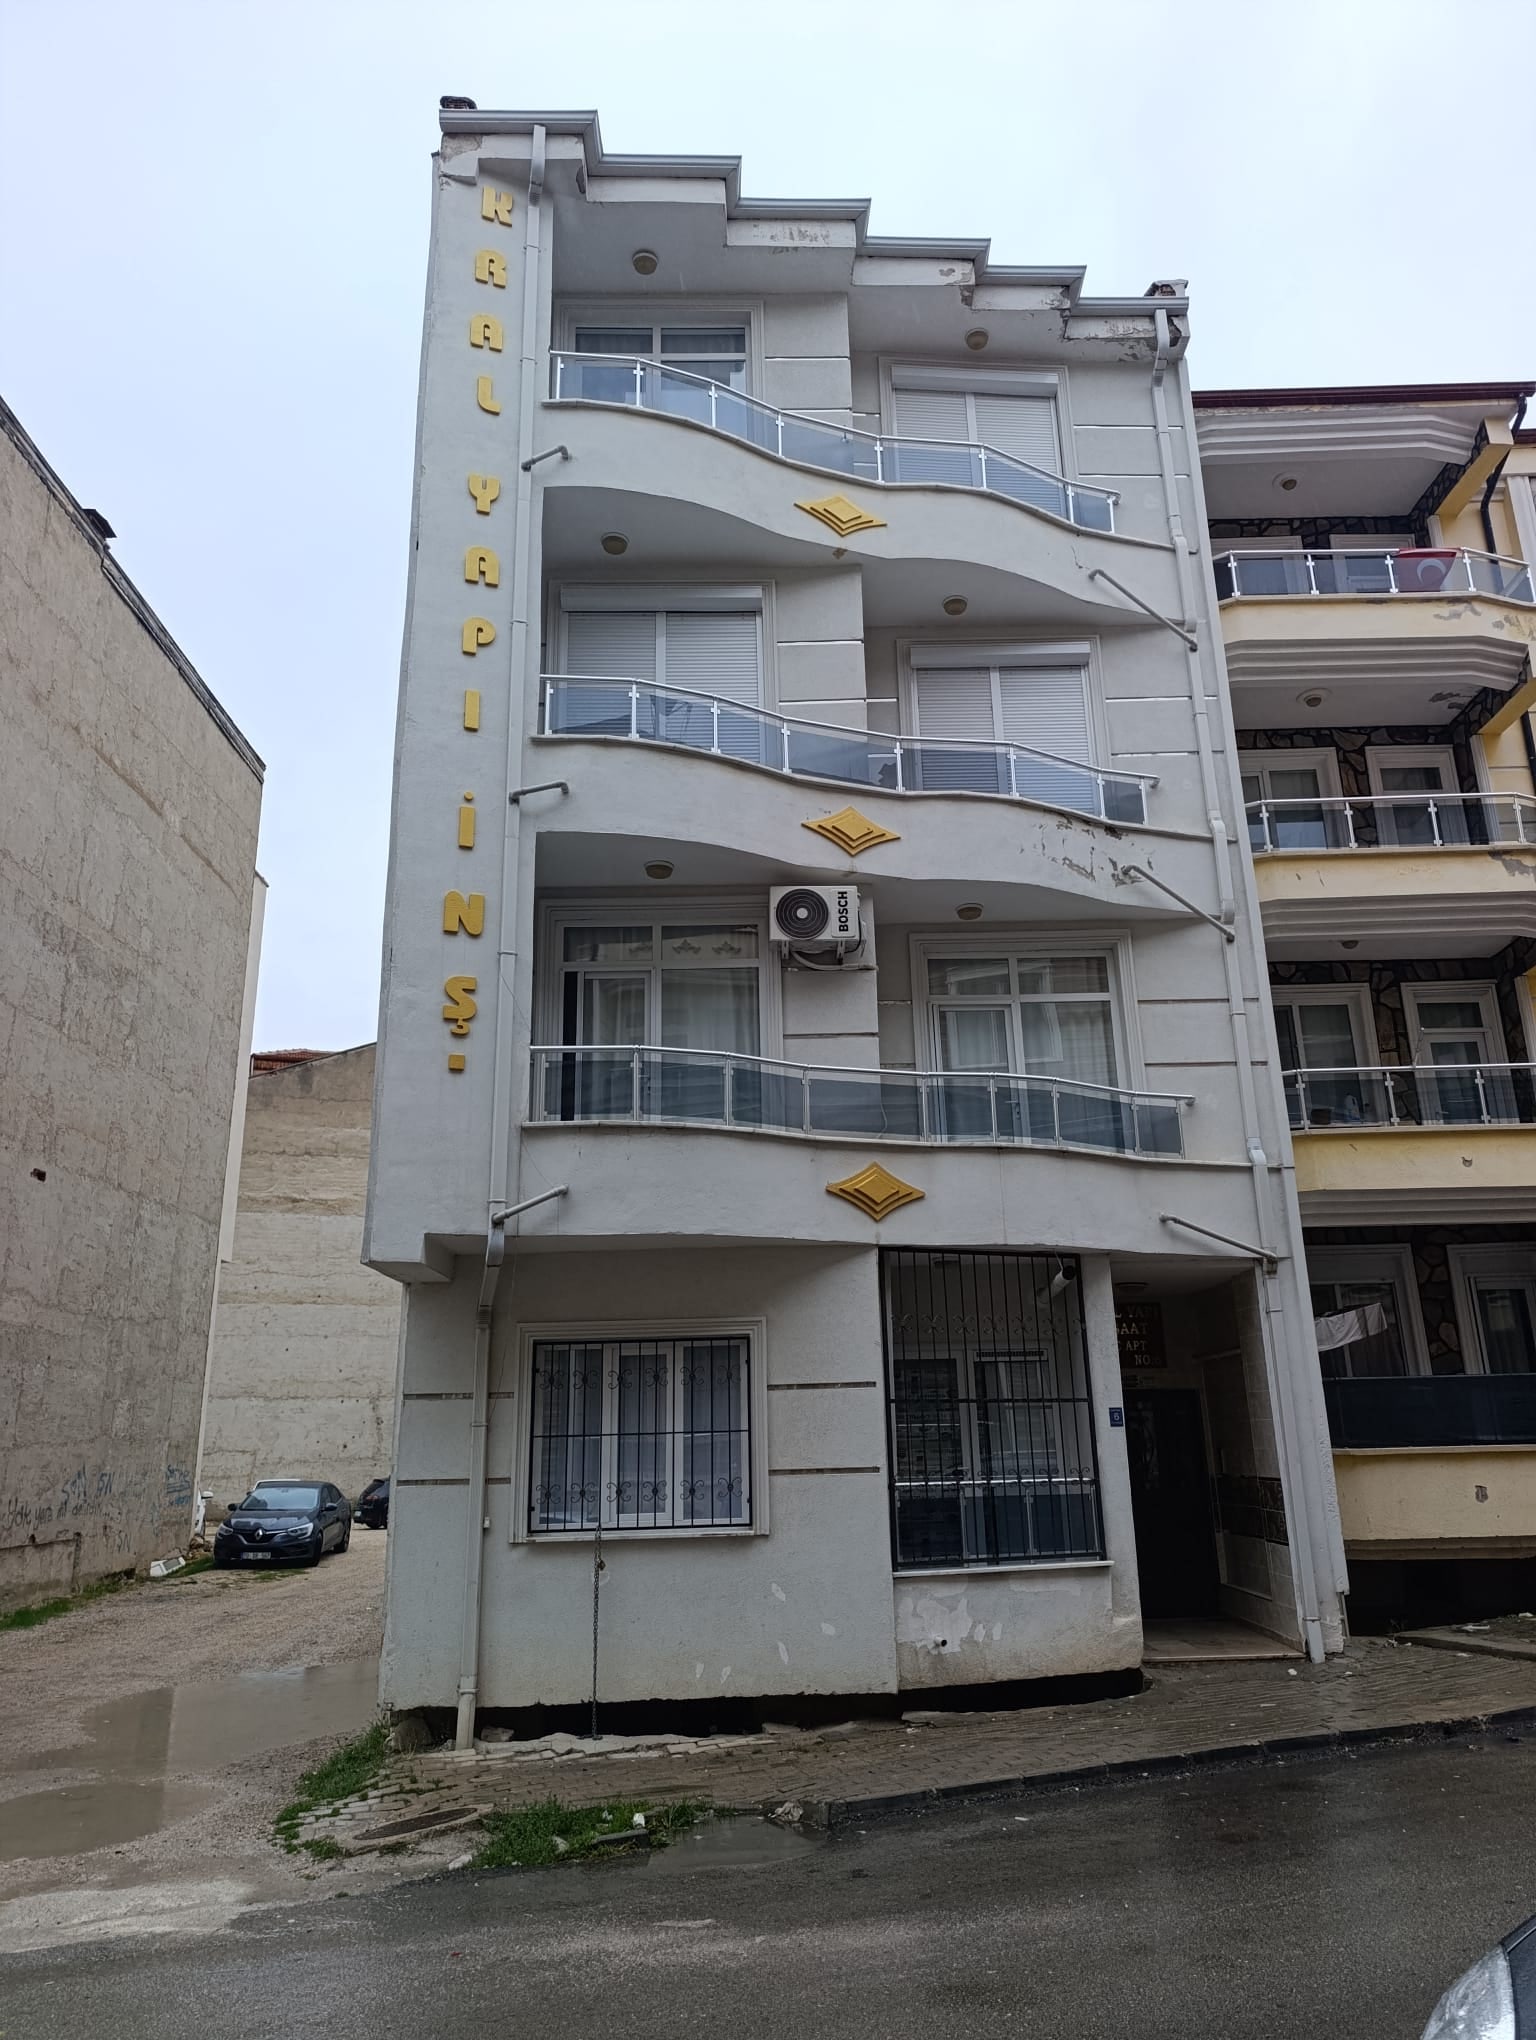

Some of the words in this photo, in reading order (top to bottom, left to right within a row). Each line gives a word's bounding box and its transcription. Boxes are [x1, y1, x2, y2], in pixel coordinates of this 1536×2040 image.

[469, 185, 515, 417] KRAL
[462, 473, 502, 732] YAPI
[442, 790, 486, 1073] İNŞ.
[837, 890, 849, 932] BOSCH
